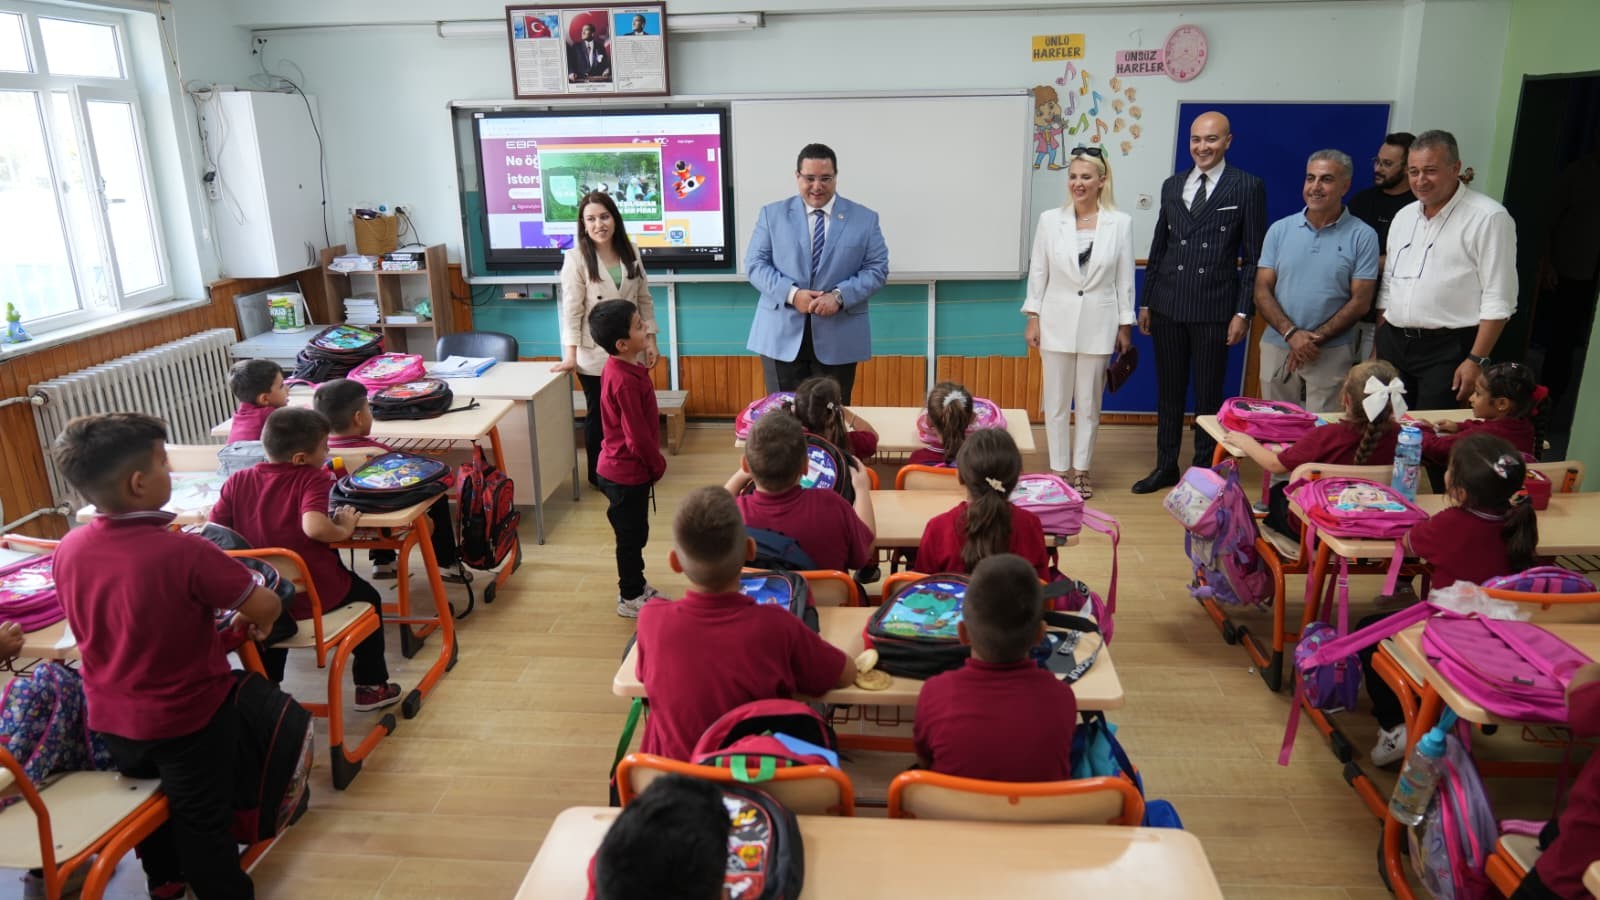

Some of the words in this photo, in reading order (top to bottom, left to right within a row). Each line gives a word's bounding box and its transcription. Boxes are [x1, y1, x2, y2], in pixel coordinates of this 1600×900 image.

[1033, 47, 1081, 58] HARFLER
[1116, 61, 1165, 74] HARFLER
[505, 155, 523, 166] Ne
